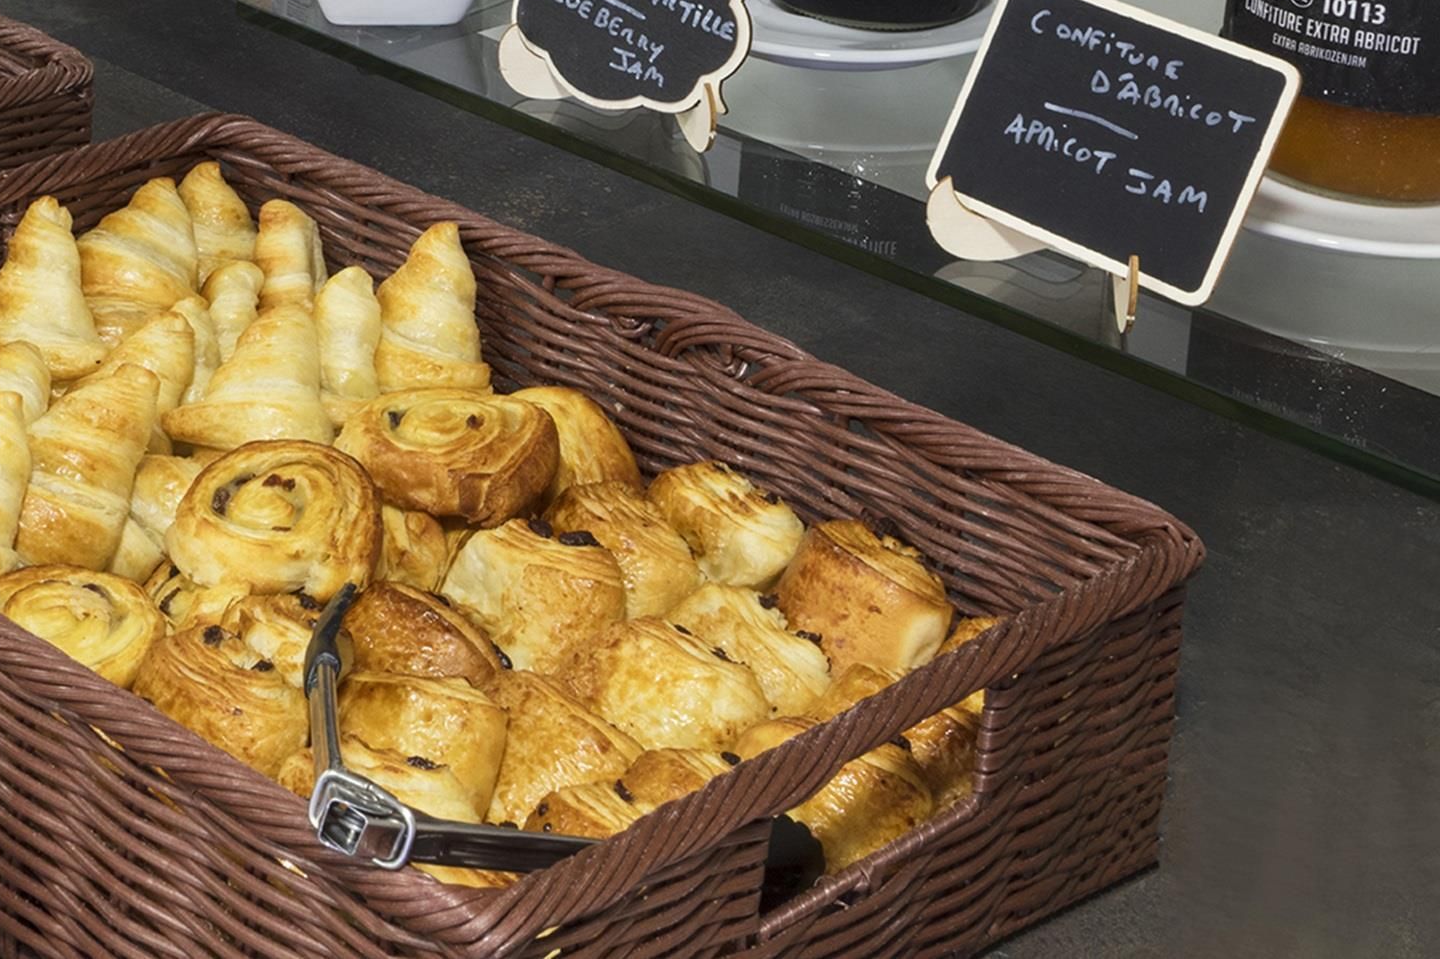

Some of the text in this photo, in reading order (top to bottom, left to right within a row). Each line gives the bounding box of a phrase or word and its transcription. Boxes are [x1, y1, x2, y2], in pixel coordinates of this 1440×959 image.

[1031, 9, 1184, 80] CONFITURE
[1272, 32, 1367, 68] EXTRA ABRIKOZENJAM
[1306, 18, 1350, 45] EXTRA
[1354, 29, 1421, 55] ABRICOT
[609, 46, 665, 88] JAM
[1004, 113, 1209, 213] APRICOT JAM
